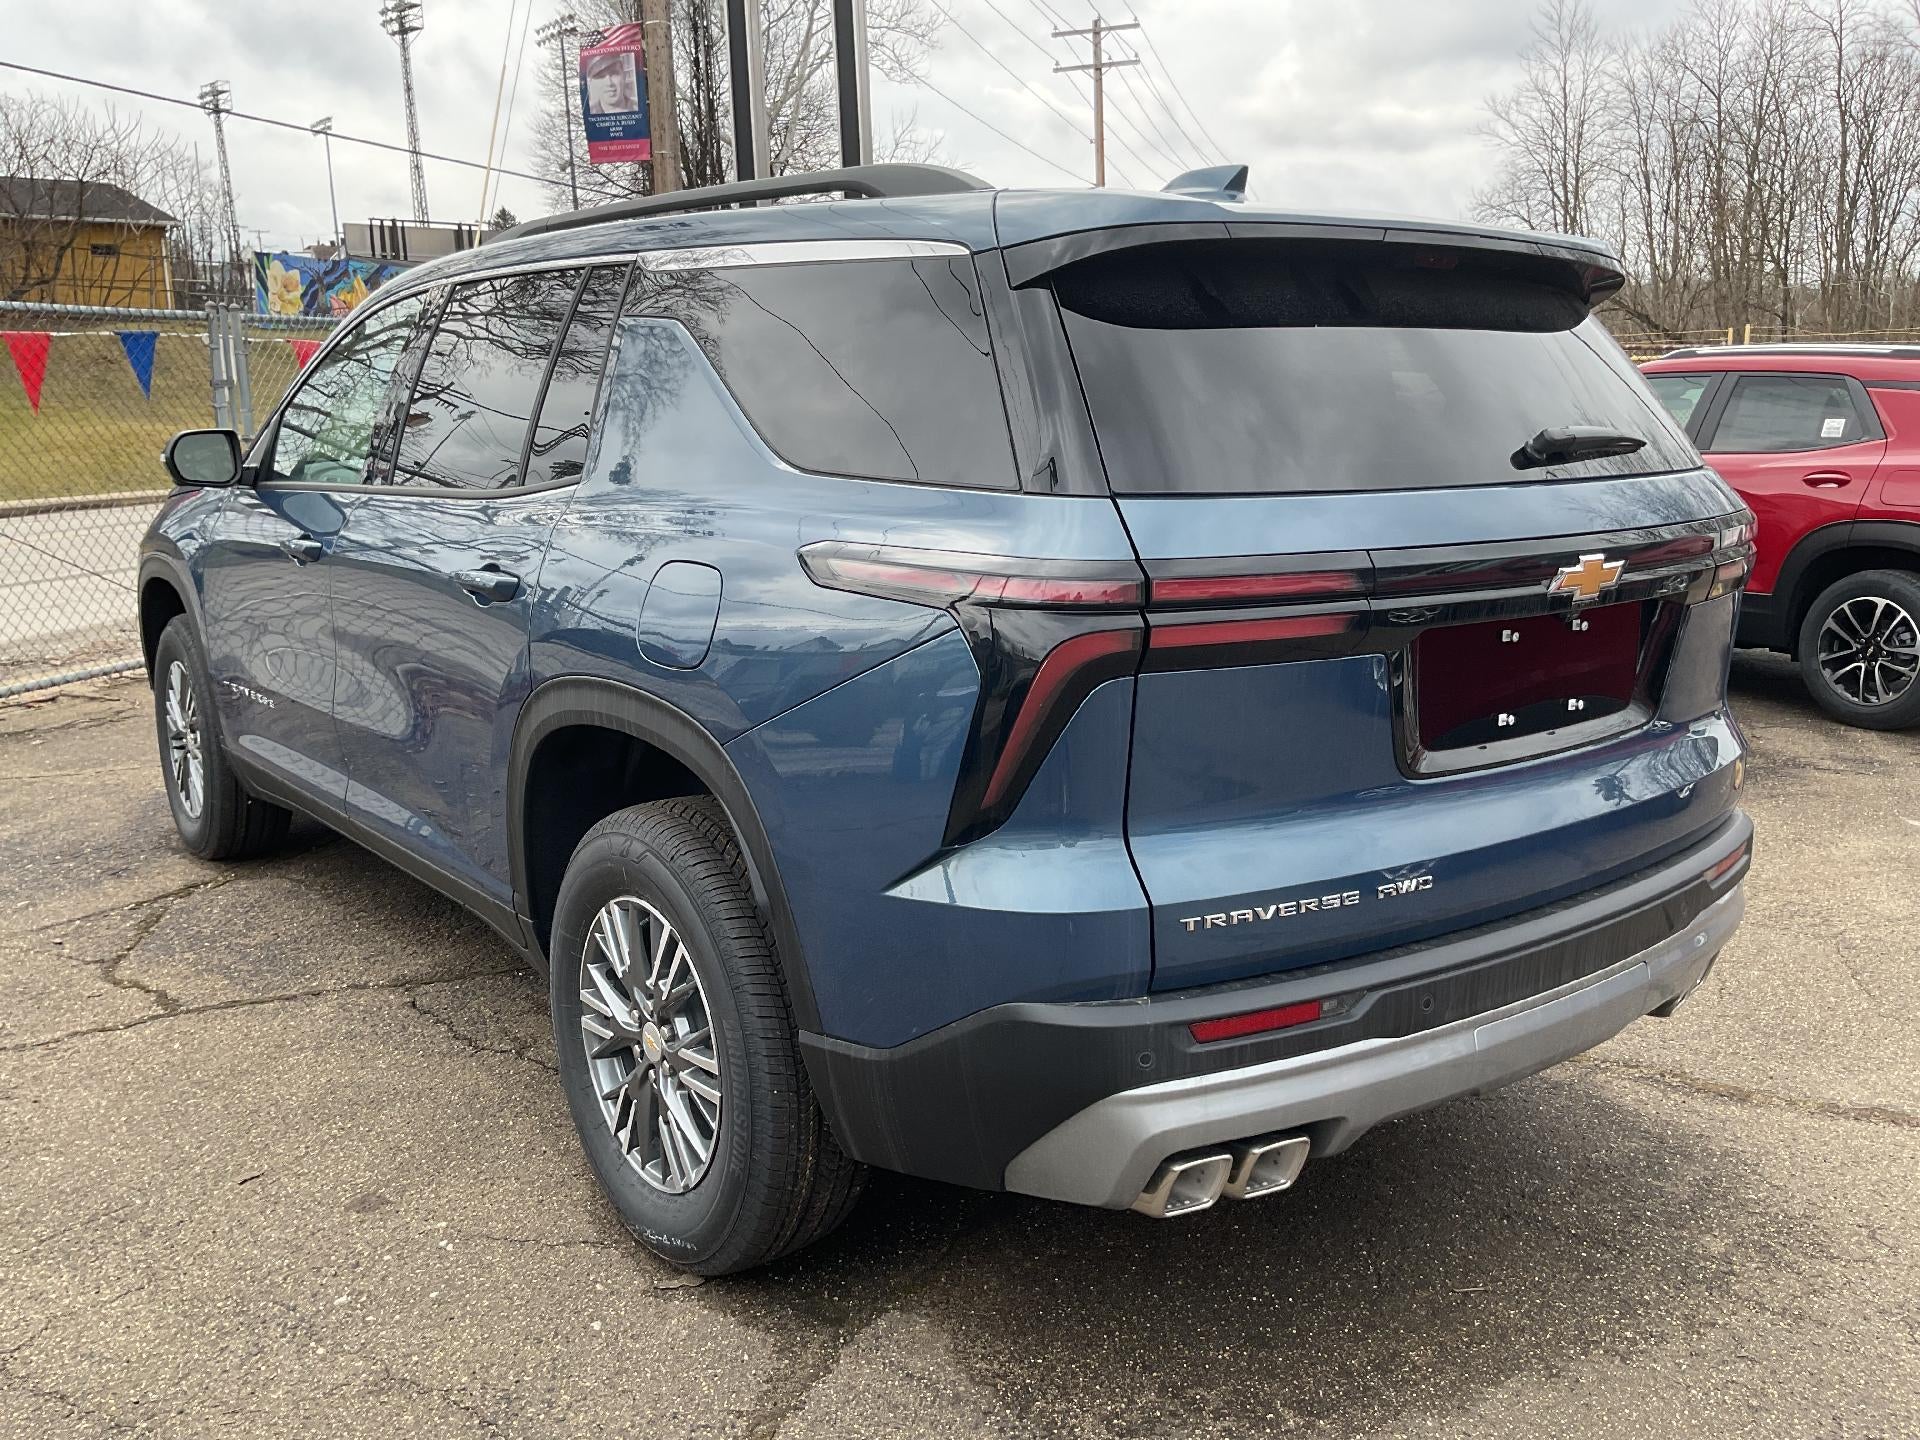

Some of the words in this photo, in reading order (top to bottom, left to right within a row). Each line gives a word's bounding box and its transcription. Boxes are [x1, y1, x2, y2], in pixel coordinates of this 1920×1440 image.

[581, 47, 621, 57] HOMETOWN
[1179, 890, 1360, 932] TRAVERSE
[1376, 875, 1433, 899] AWD
